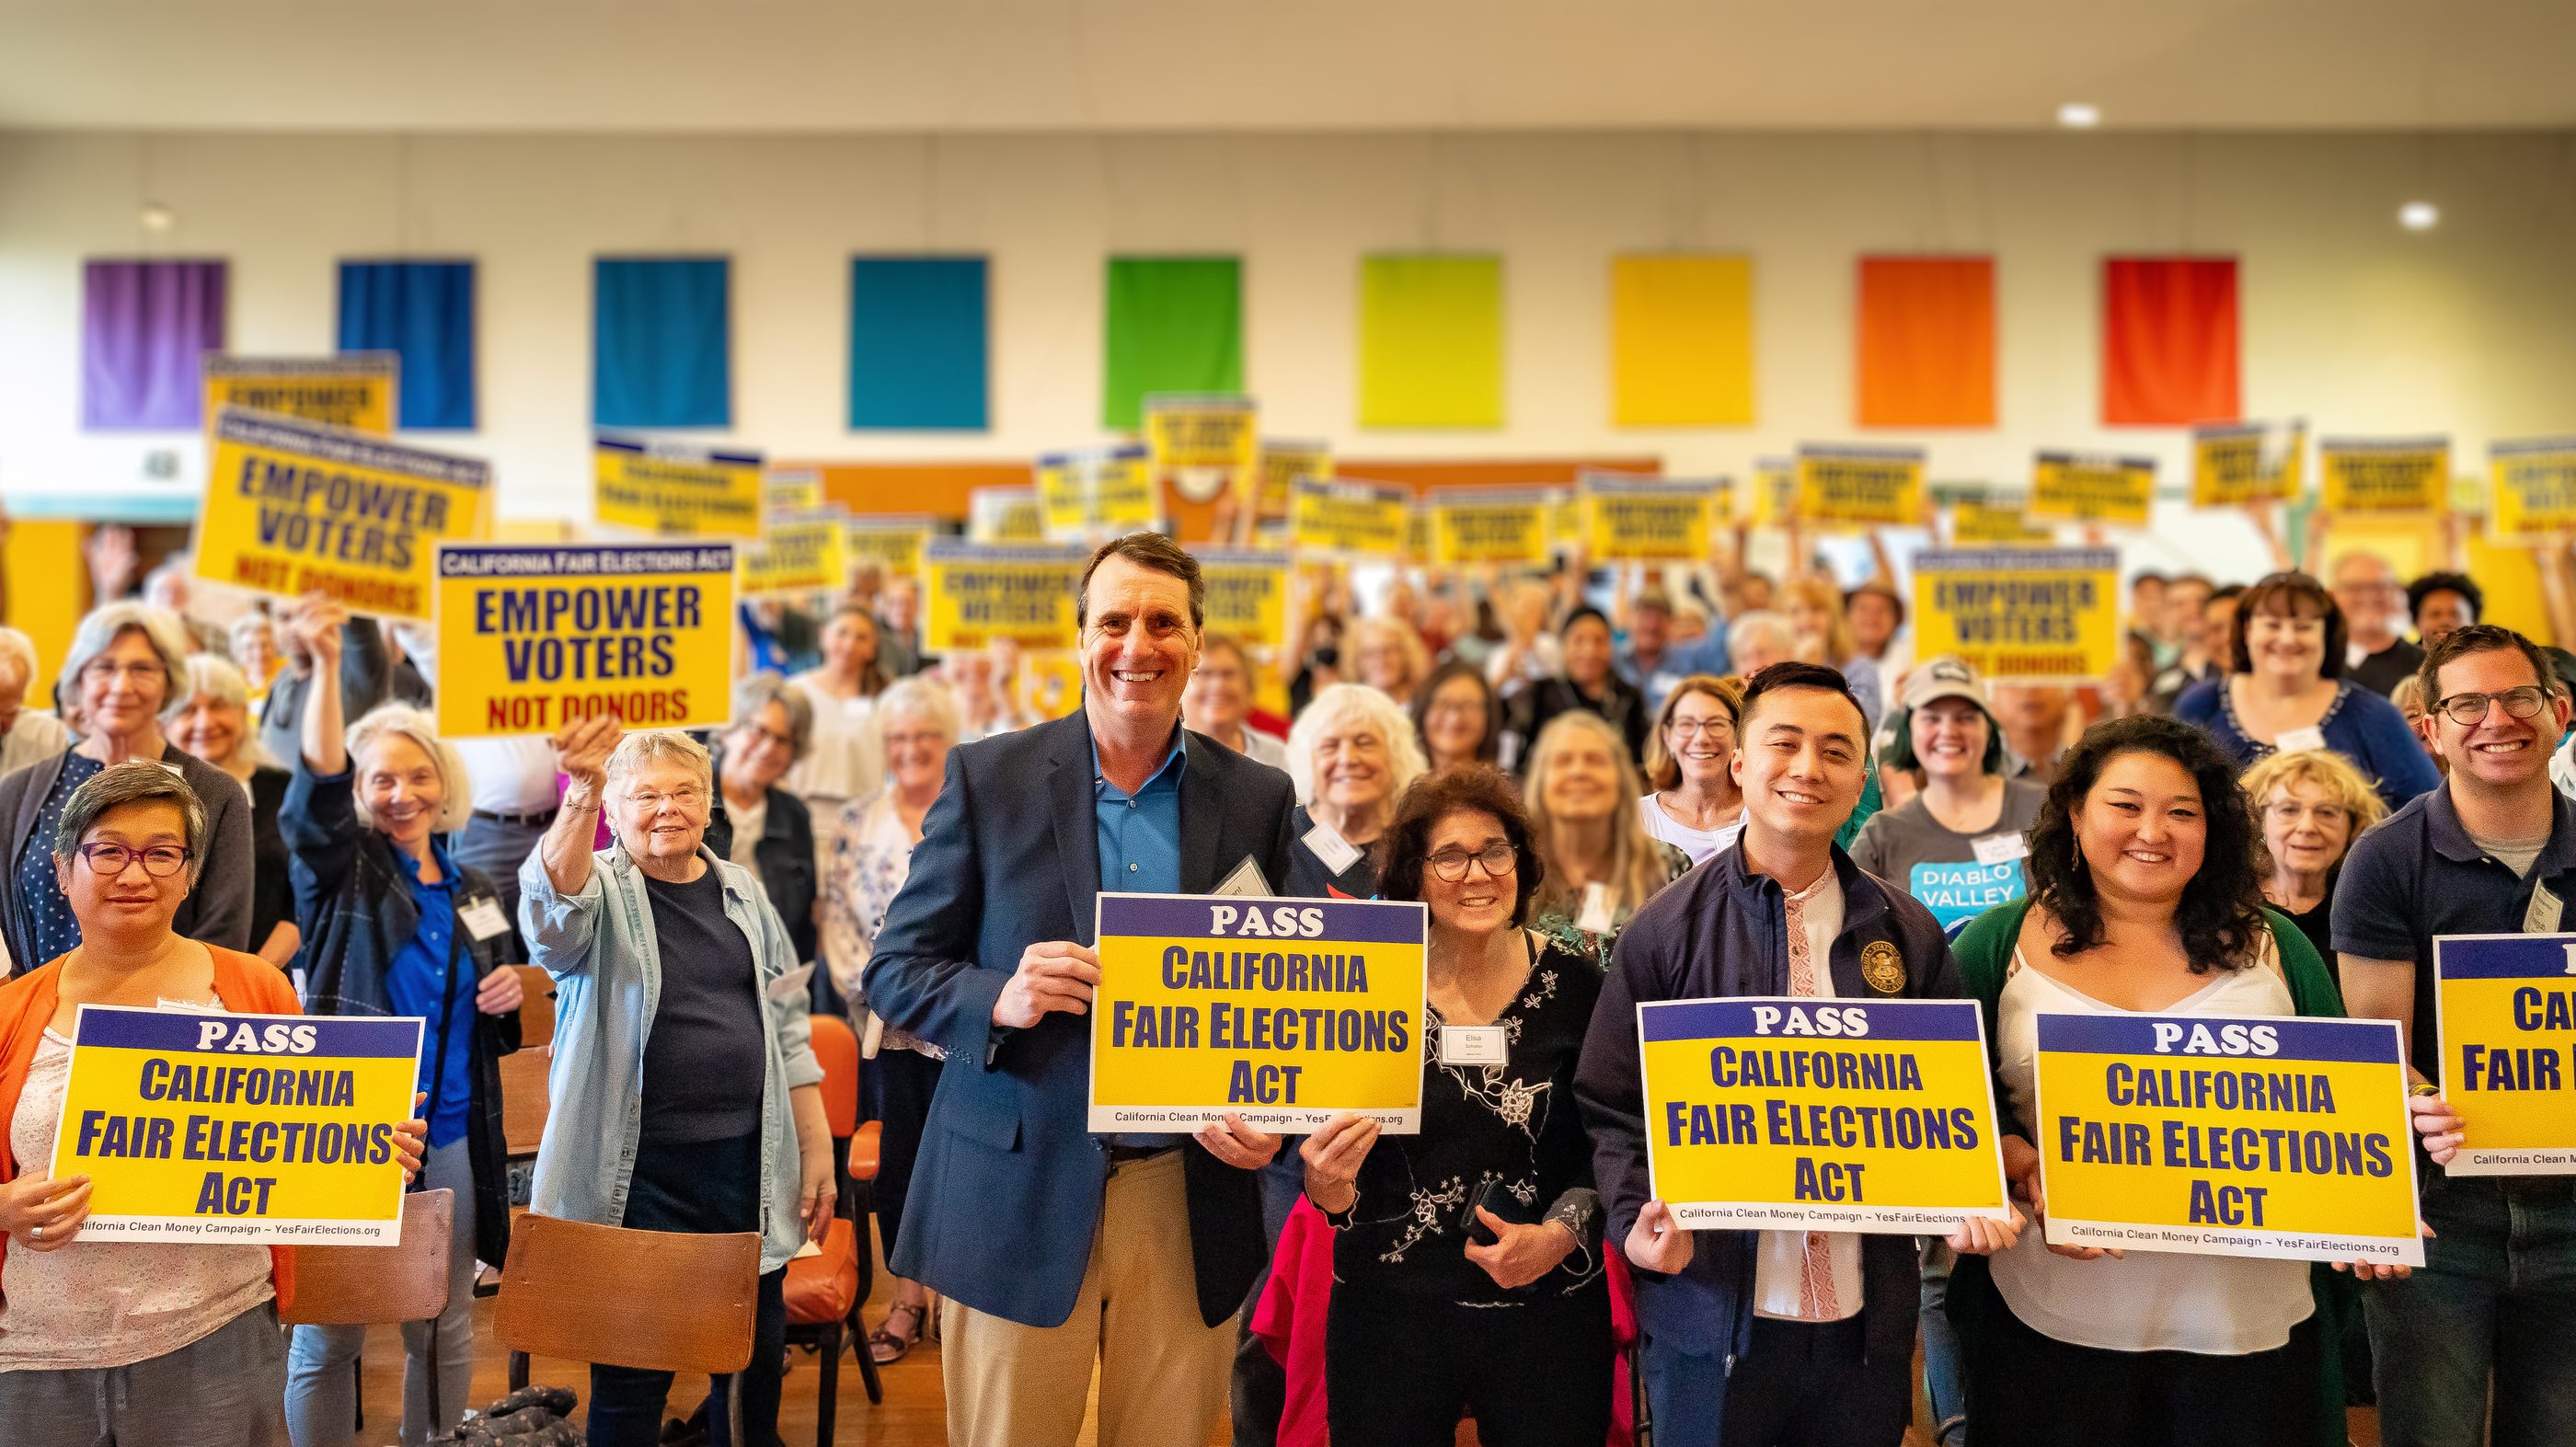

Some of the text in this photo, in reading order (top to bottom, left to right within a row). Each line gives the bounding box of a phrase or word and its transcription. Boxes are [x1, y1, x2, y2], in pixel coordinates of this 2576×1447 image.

[239, 456, 449, 534] EMPOWER
[259, 502, 417, 571] VOTERS
[236, 554, 291, 593] NOT
[443, 549, 731, 575] CALIFORNIA FAIR ELECTIONS ACT
[476, 586, 701, 634] EMPOWER
[503, 636, 676, 682] VOTERS
[488, 690, 688, 729] NOT DONORS
[1923, 864, 2012, 886] DIABLO
[1923, 885, 2014, 907] VALLEY
[1210, 905, 1324, 937] PASS
[1161, 945, 1368, 993] CALIFORNIA
[196, 1021, 317, 1054] PASS
[1112, 1000, 1409, 1052] FAIR ELECTIONS
[1753, 1005, 1869, 1037] PASS
[2152, 1022, 2279, 1056] PASS
[139, 1058, 355, 1107] CALIFORNIA
[1227, 1060, 1302, 1104] ACT
[1710, 1046, 1923, 1091] CALIFORNIA
[2106, 1062, 2336, 1113] CALIFORNIA
[2462, 1044, 2561, 1091] FAIR
[75, 1110, 393, 1165] FAIR ELECTIONS
[1115, 1112, 1166, 1121] California
[1168, 1112, 1198, 1121] Clean
[1239, 1112, 1293, 1124] Campaign
[1666, 1099, 1979, 1150] FAIR ELECTIONS
[2059, 1116, 2393, 1177] FAIR ELECTIONS
[2473, 1154, 2529, 1166] California
[2533, 1154, 2566, 1165] Clean
[195, 1172, 277, 1215] ACT
[1794, 1157, 1865, 1202] ACT
[1680, 1209, 1732, 1219] California
[1736, 1208, 1766, 1218] Clean
[1770, 1209, 1804, 1221] Money
[1809, 1211, 1862, 1223] Campaign
[1874, 1212, 1966, 1223] YesFairElections
[2189, 1179, 2268, 1227] ACT
[79, 1221, 126, 1232] alifornia
[129, 1222, 162, 1233] Clean
[165, 1223, 202, 1235] Money
[205, 1223, 261, 1235] Campaign
[275, 1224, 381, 1237] YesFairElections.org
[2071, 1225, 2123, 1238] California
[2126, 1229, 2158, 1240] Clean
[2162, 1231, 2199, 1244] Money
[2203, 1234, 2261, 1247] Campaign
[2276, 1237, 2399, 1256] YesFairElections.org
